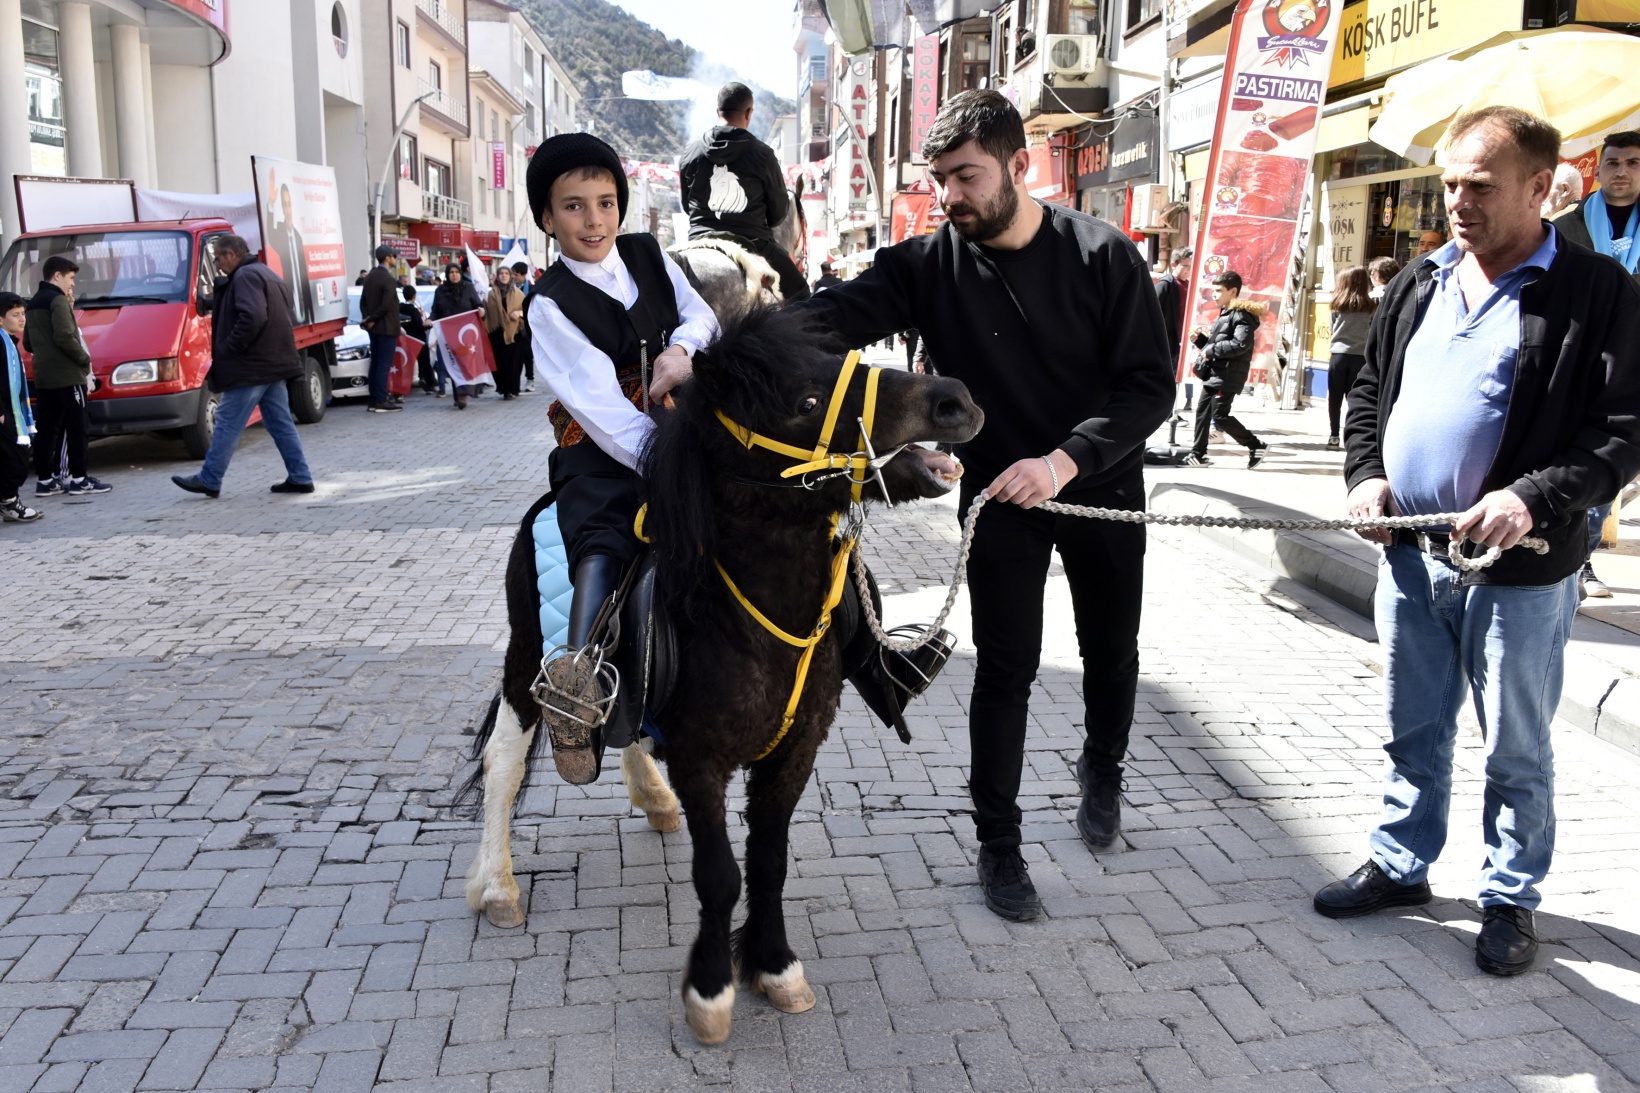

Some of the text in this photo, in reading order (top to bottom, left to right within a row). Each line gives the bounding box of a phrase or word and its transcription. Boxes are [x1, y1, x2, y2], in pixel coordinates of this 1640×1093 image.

[1342, 13, 1385, 61] KÖŞK
[1235, 75, 1320, 102] PASTIRMA
[850, 84, 867, 199] ATALAY
[1328, 216, 1356, 240] KÖŞK
